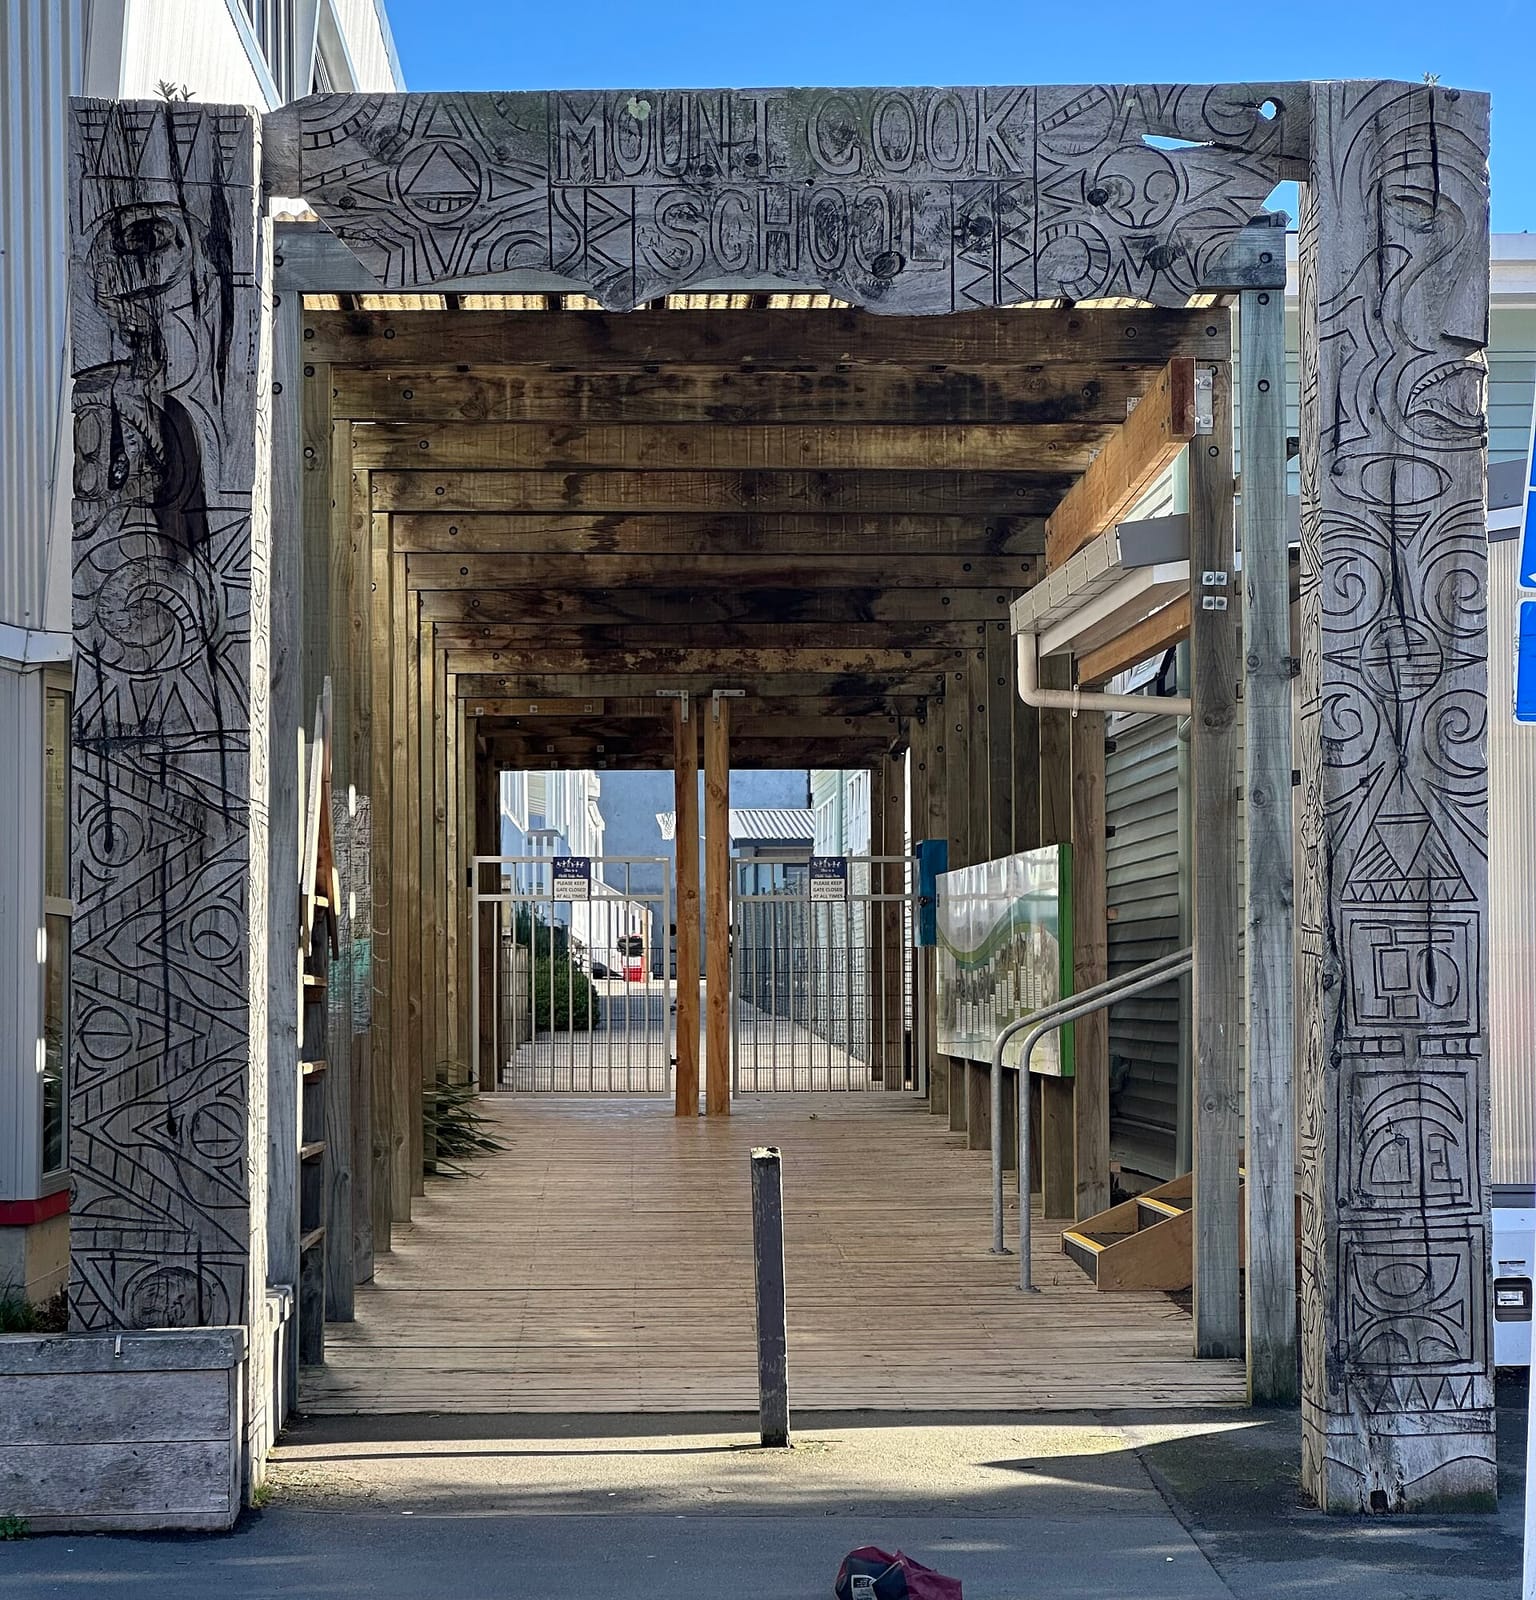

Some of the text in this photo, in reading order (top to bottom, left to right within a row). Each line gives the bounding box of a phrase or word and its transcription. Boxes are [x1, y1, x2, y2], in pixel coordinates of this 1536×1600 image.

[559, 87, 1024, 182] MOUNT COOK
[642, 188, 945, 281] SCHOOL
